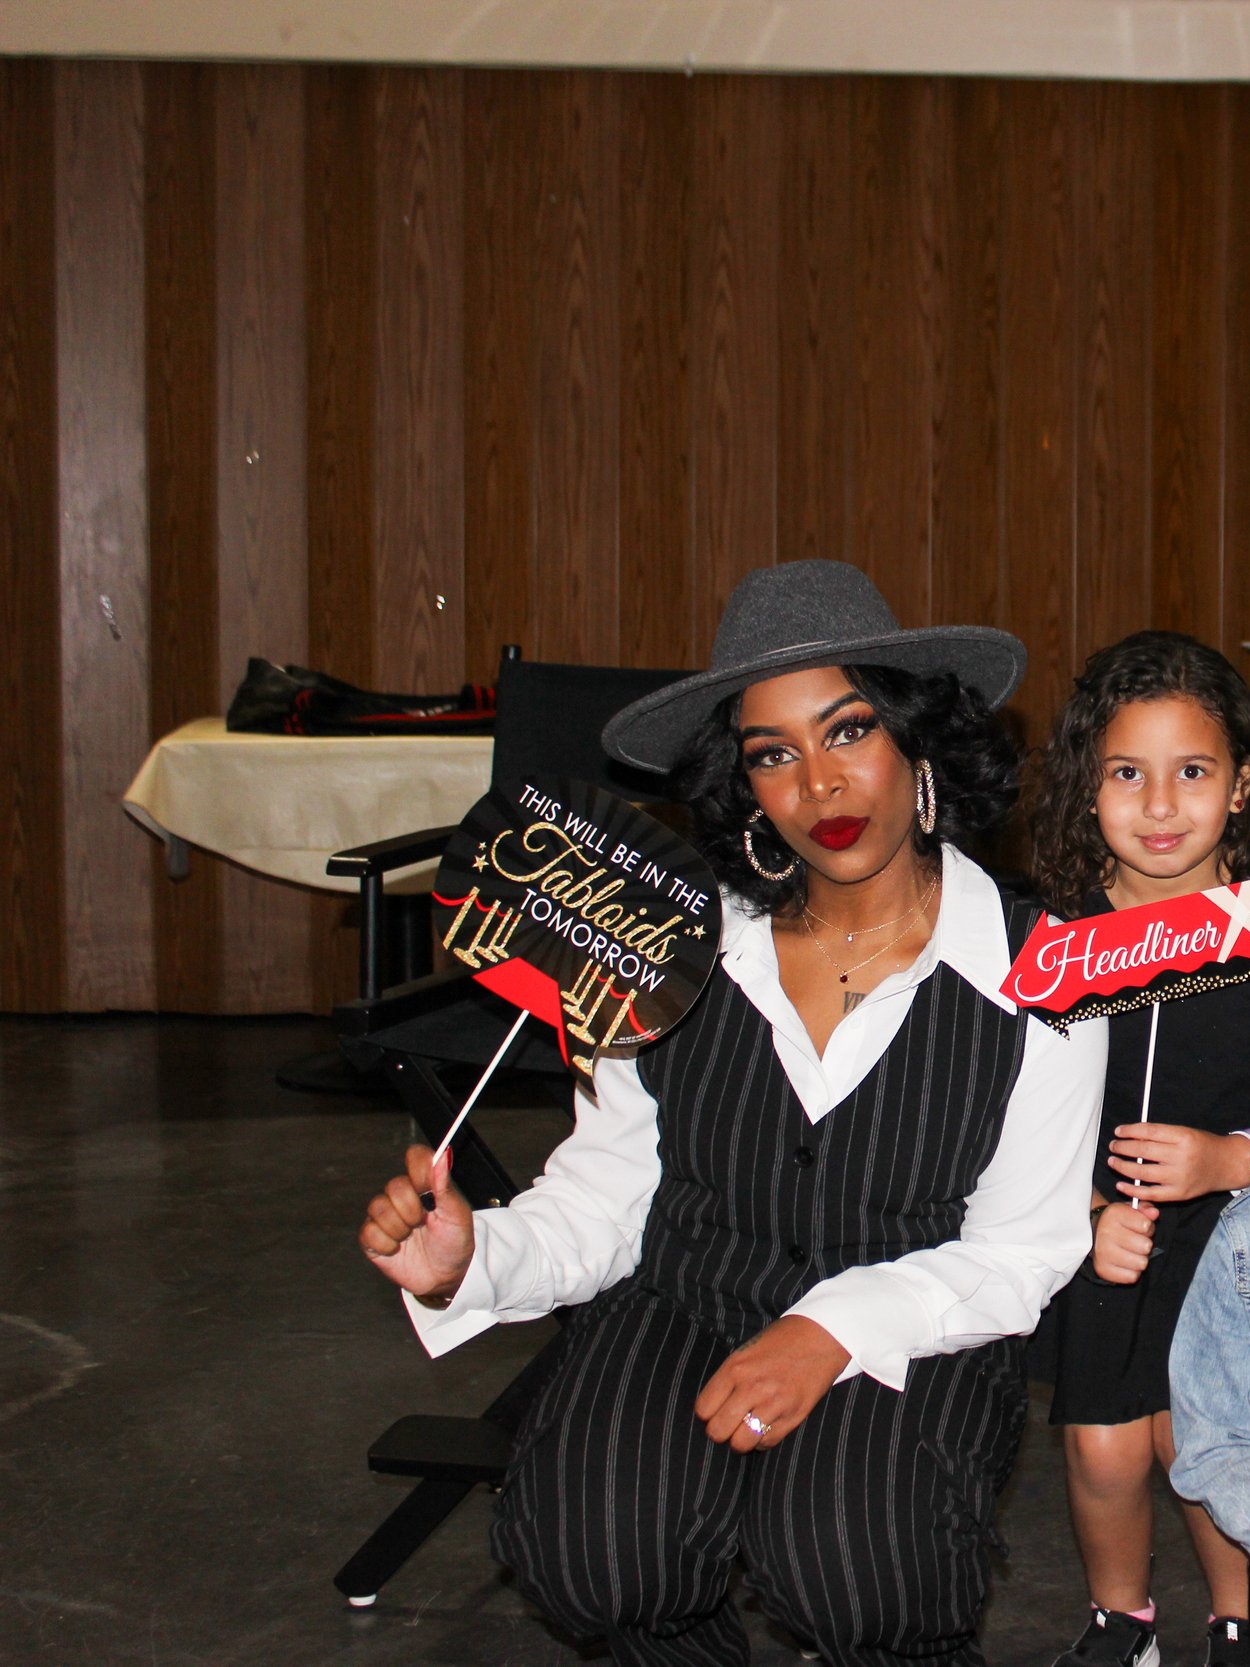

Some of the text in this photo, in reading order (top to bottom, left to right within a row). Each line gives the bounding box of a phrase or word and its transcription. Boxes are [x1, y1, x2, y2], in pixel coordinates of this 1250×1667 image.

[490, 821, 683, 965] Tabloids
[518, 783, 709, 915] THIS WILL BE IN THE
[519, 888, 666, 993] TOMORROW
[1014, 920, 1222, 1002] Headliner
